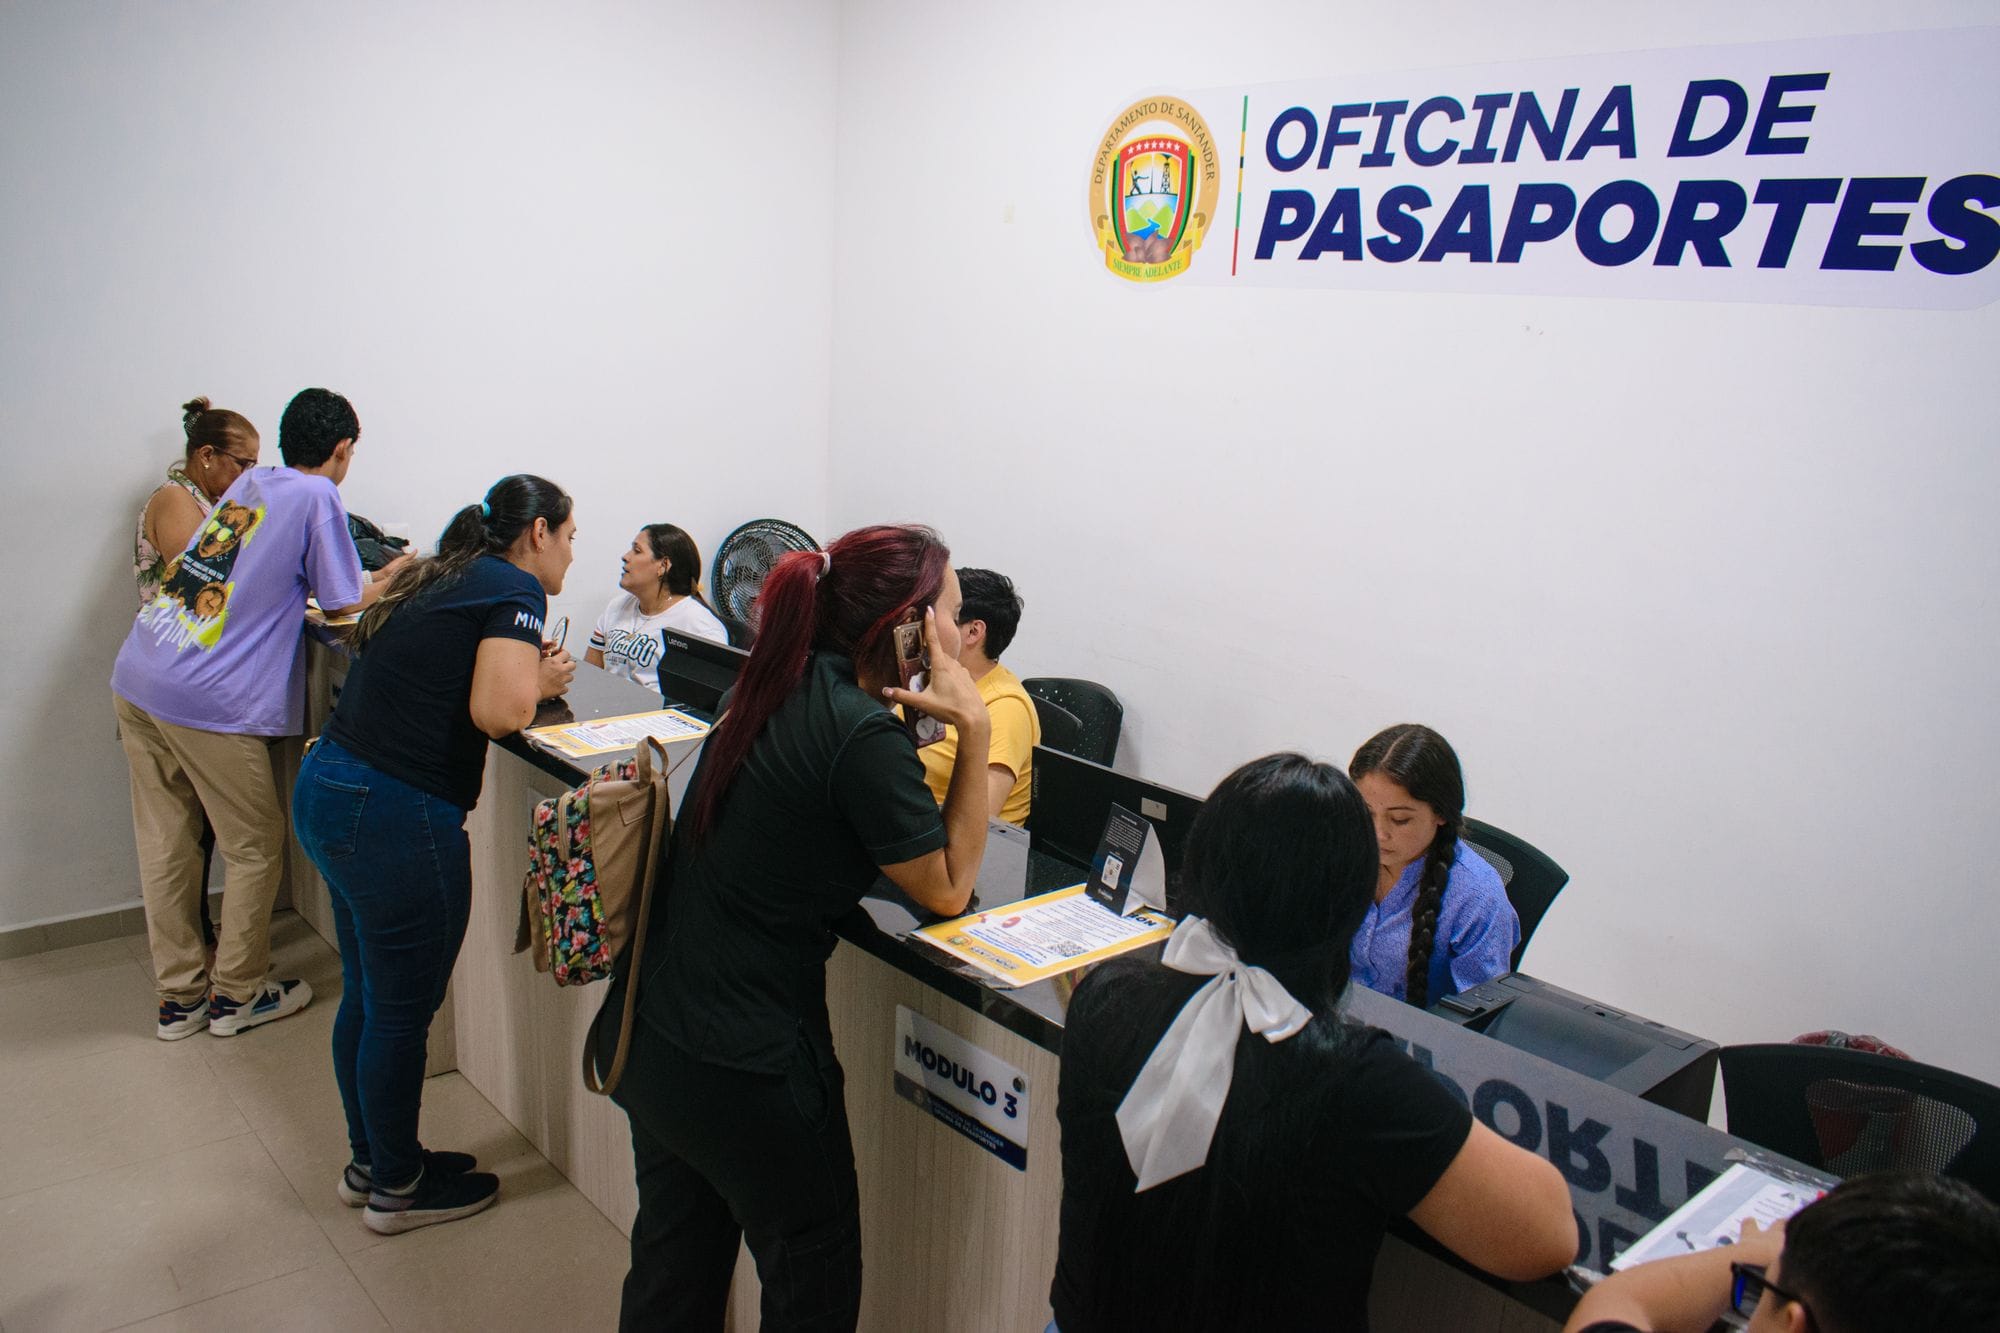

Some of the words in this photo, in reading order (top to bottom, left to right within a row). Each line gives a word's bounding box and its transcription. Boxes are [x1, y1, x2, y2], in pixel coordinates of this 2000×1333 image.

[1094, 102, 1158, 184] DEPARTAMENTO
[1160, 102, 1174, 116] DE
[1175, 107, 1215, 181] SANTANDER
[1265, 84, 1637, 173] OFICINA
[1666, 71, 1831, 158] DE
[1254, 173, 2000, 276] PASAPORTES
[1112, 258, 1143, 278] SIEMPRE
[1143, 258, 1183, 278] ADELANTE
[905, 1035, 997, 1106] MODULO
[1003, 1092, 1017, 1118] 3
